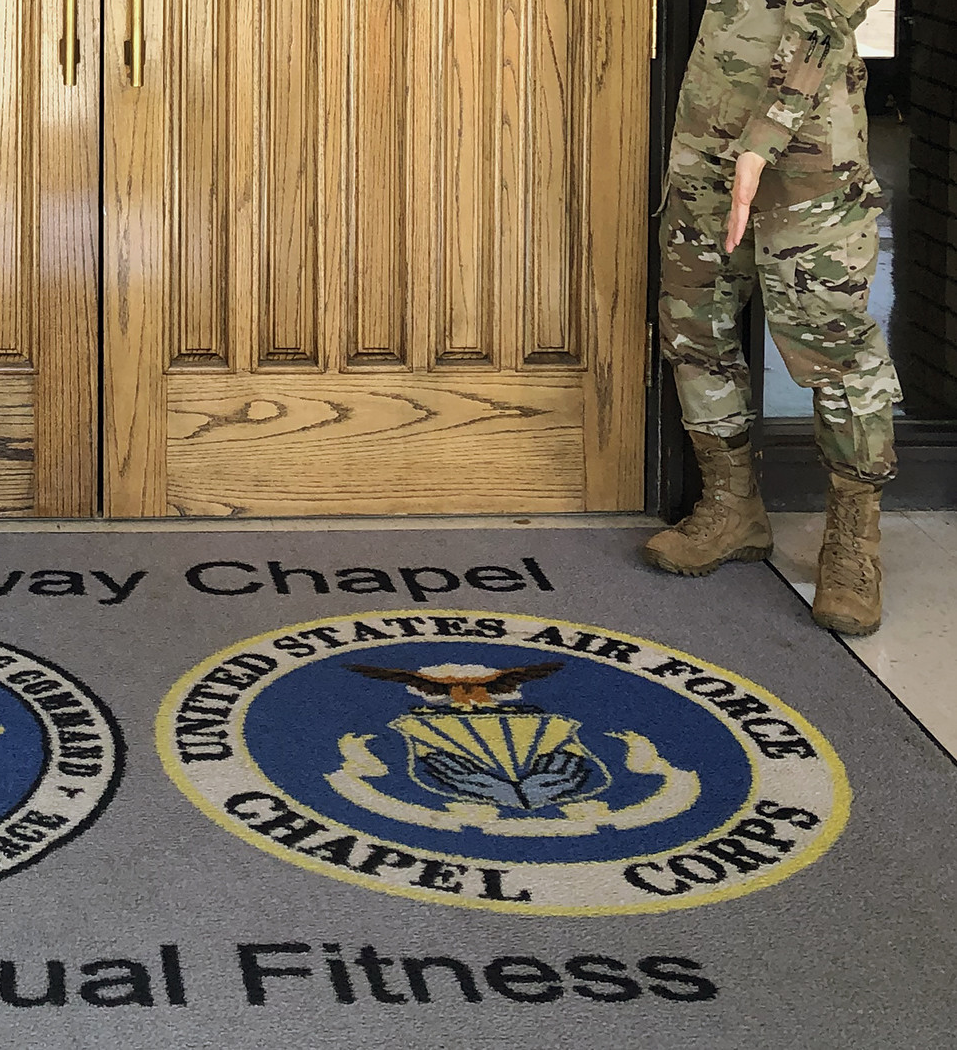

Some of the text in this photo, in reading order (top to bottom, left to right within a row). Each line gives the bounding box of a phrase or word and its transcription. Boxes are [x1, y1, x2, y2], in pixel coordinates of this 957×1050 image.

[185, 558, 554, 602] Chapel
[6, 669, 103, 778] COMMAND
[175, 617, 815, 764] UNITED STATES AIR FORCE
[225, 790, 819, 903] CHAPEL CORPS
[236, 942, 720, 1006] Fitness
